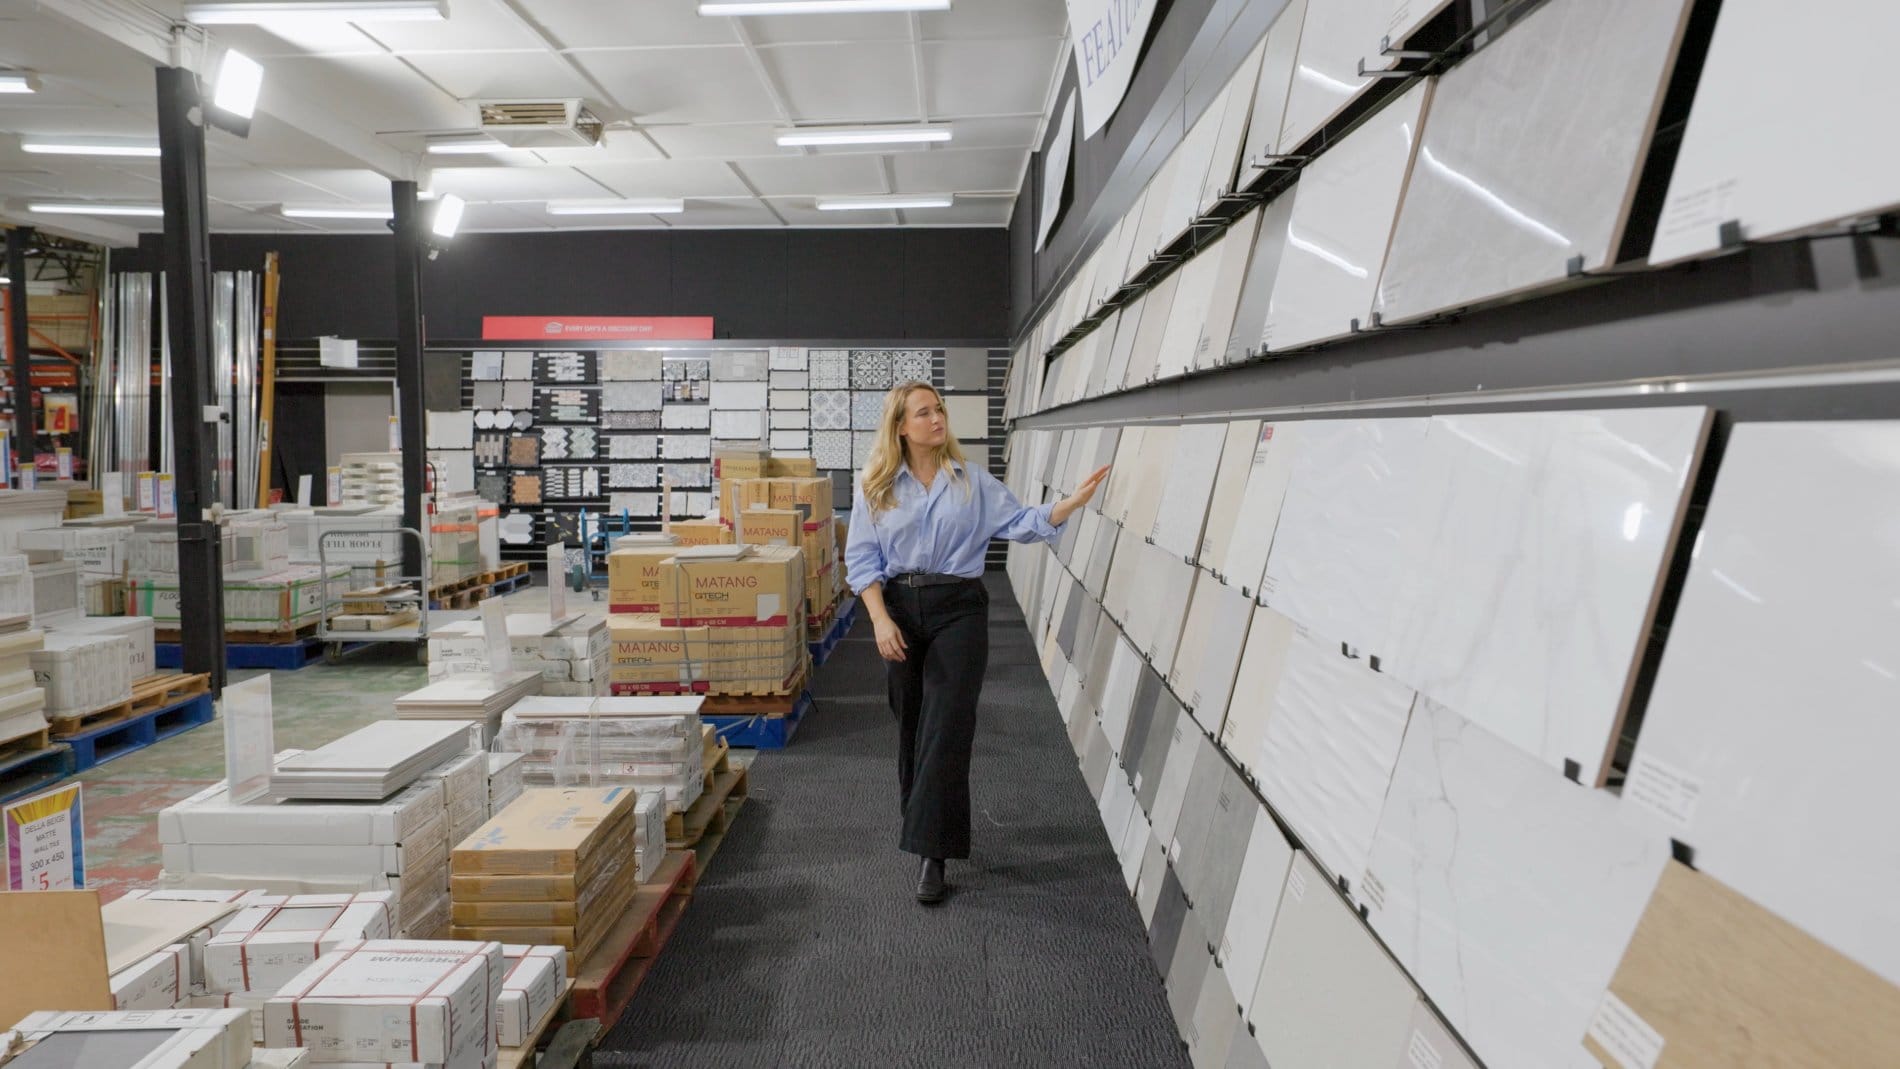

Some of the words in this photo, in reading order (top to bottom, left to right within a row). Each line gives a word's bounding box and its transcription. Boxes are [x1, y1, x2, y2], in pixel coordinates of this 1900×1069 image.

[1081, 0, 1140, 88] FEATU
[565, 325, 583, 333] EVERY
[743, 528, 788, 537] MATANG
[326, 540, 345, 548] TILE
[349, 540, 381, 548] FLOOR
[696, 576, 758, 588] MATANG
[618, 641, 680, 653] MATANG
[36, 829, 57, 842] MATTE
[30, 858, 44, 872] 300
[51, 850, 65, 862] 450
[39, 871, 49, 891] 5
[369, 956, 462, 964] PREMIUM
